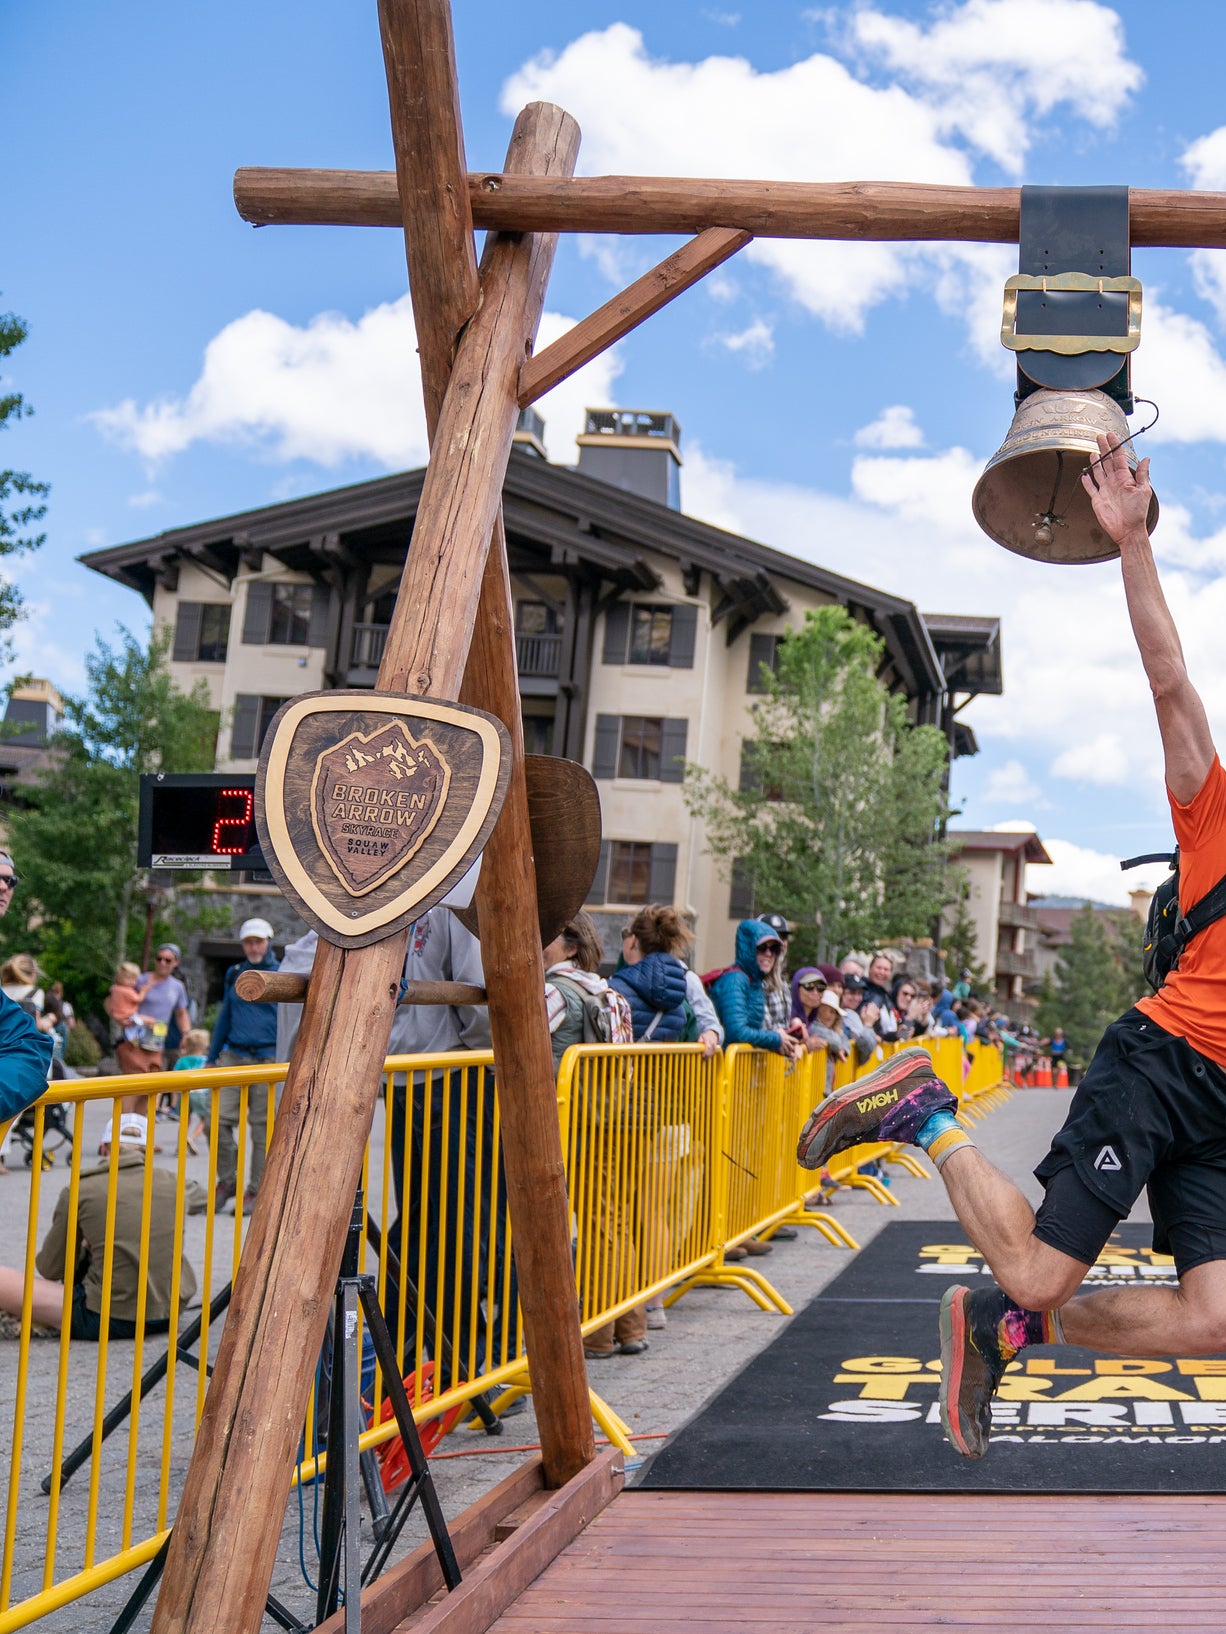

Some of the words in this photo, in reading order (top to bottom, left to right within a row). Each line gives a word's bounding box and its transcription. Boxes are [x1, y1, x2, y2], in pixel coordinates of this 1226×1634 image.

[332, 784, 427, 810] BROKEN
[212, 790, 252, 855] 2
[332, 803, 417, 826] ARROW
[341, 823, 399, 839] SKYRACE
[348, 838, 389, 849] SQUAW
[348, 846, 386, 857] VALLEY
[856, 1088, 899, 1114] HOKA
